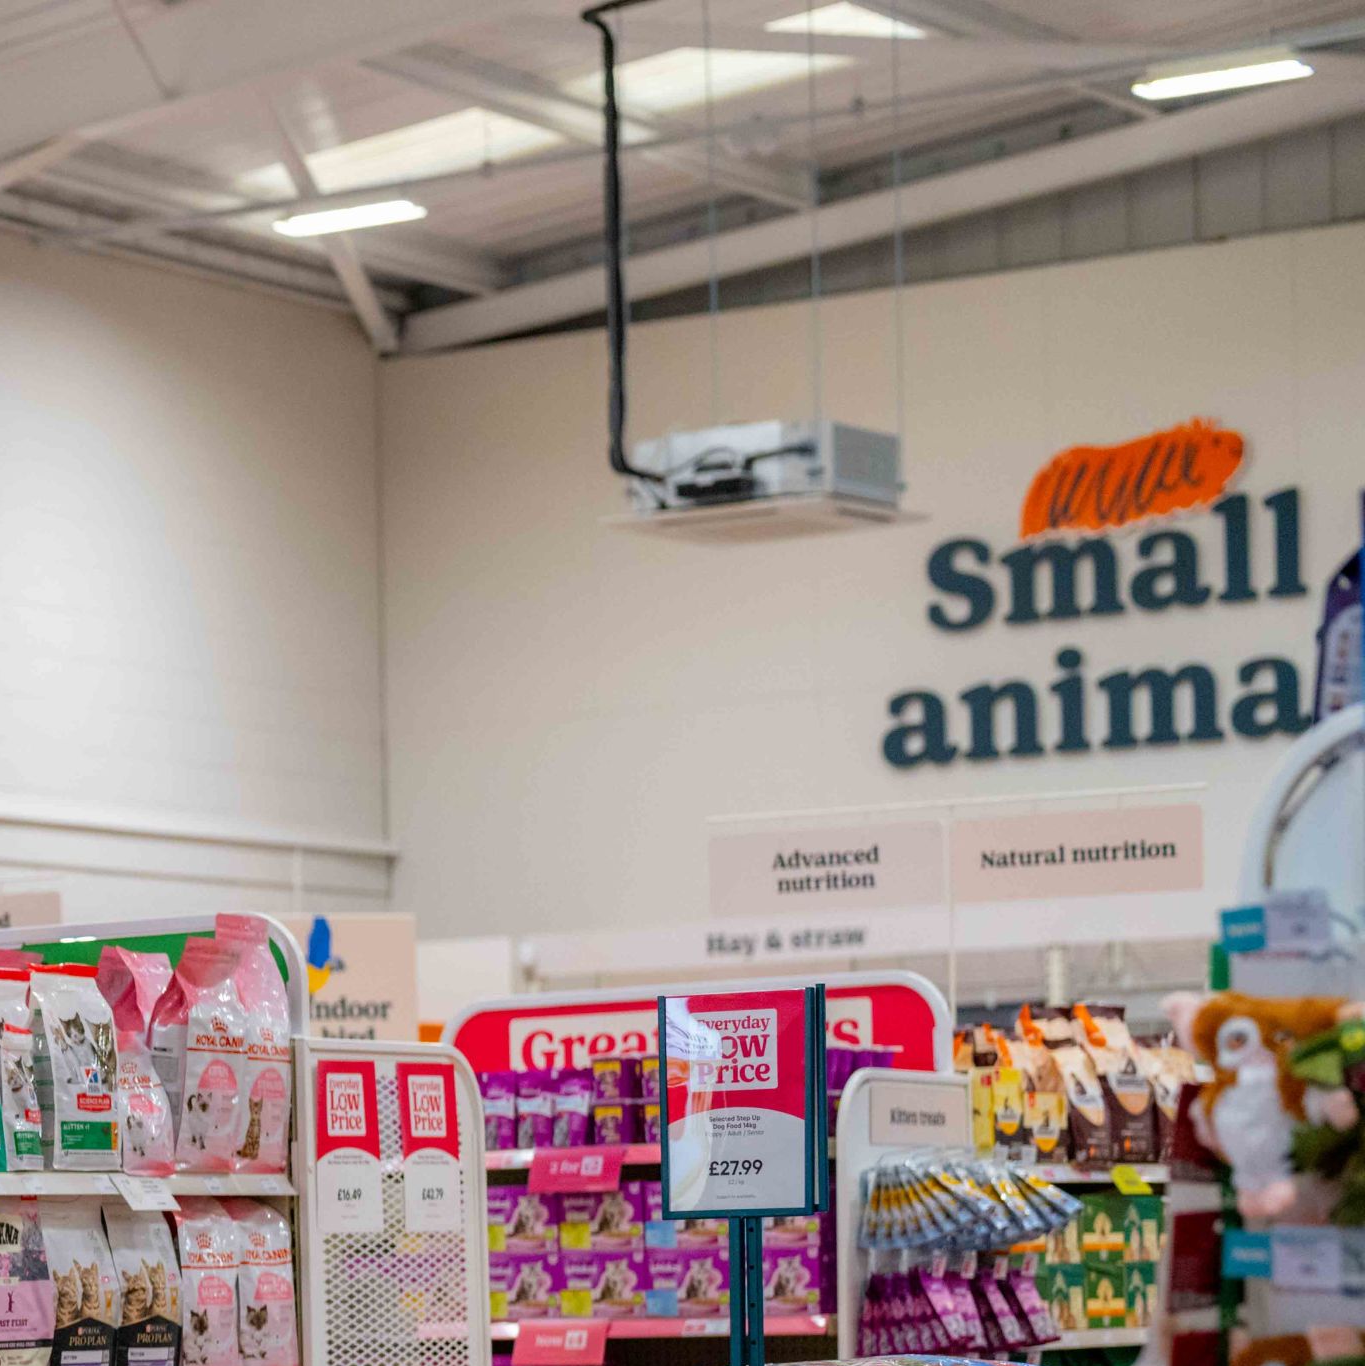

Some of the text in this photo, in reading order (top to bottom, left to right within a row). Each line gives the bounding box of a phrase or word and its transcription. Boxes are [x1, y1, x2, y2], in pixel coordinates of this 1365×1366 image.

[926, 487, 1307, 633] Small
[881, 647, 1315, 771] anima
[771, 845, 880, 871] Advanced
[980, 839, 1177, 869] Natural nutrition
[777, 870, 877, 895] nutrition
[706, 932, 757, 959] Hay
[790, 926, 866, 951] straw
[309, 998, 392, 1021] Indoor
[195, 1034, 218, 1048] ROYAL
[522, 1029, 659, 1072] Grea
[721, 1034, 770, 1060] OW
[697, 1058, 771, 1086] Price
[329, 1078, 360, 1090] Everyday
[411, 1081, 441, 1092] Everyday
[330, 1090, 360, 1111] LOW
[412, 1091, 442, 1113] LOW
[330, 1111, 362, 1131] Price
[413, 1112, 443, 1131] Price
[712, 1122, 757, 1130] Dog Food 14kg
[736, 1115, 751, 1123] Step
[751, 1114, 761, 1122] Up
[709, 1159, 763, 1177] £27.99
[337, 1188, 362, 1201] £16.49
[69, 1335, 107, 1346] PRO PLAN
[137, 1333, 173, 1344] PRO PLAN
